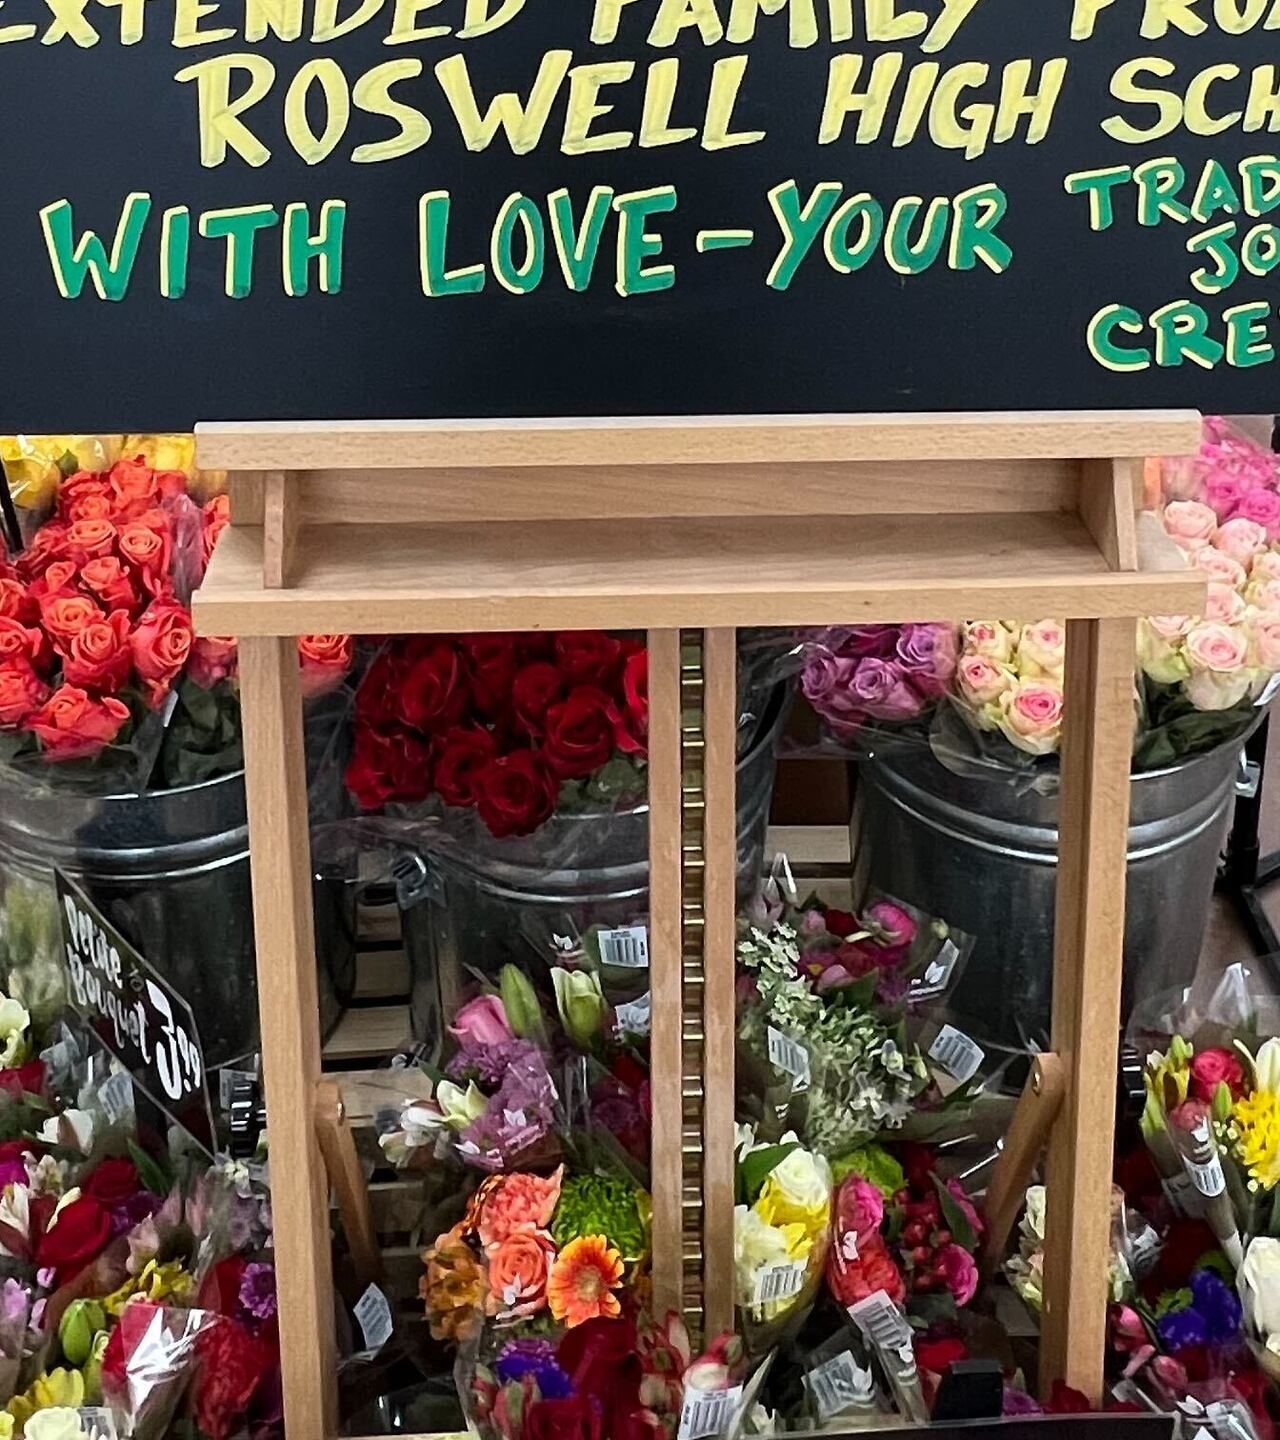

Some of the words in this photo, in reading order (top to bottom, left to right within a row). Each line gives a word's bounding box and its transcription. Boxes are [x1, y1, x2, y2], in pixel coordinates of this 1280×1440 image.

[176, 50, 765, 167] ROSWELL
[818, 52, 1068, 159] HIGH
[40, 192, 346, 300] WITH
[66, 942, 152, 1065] Bouquet
